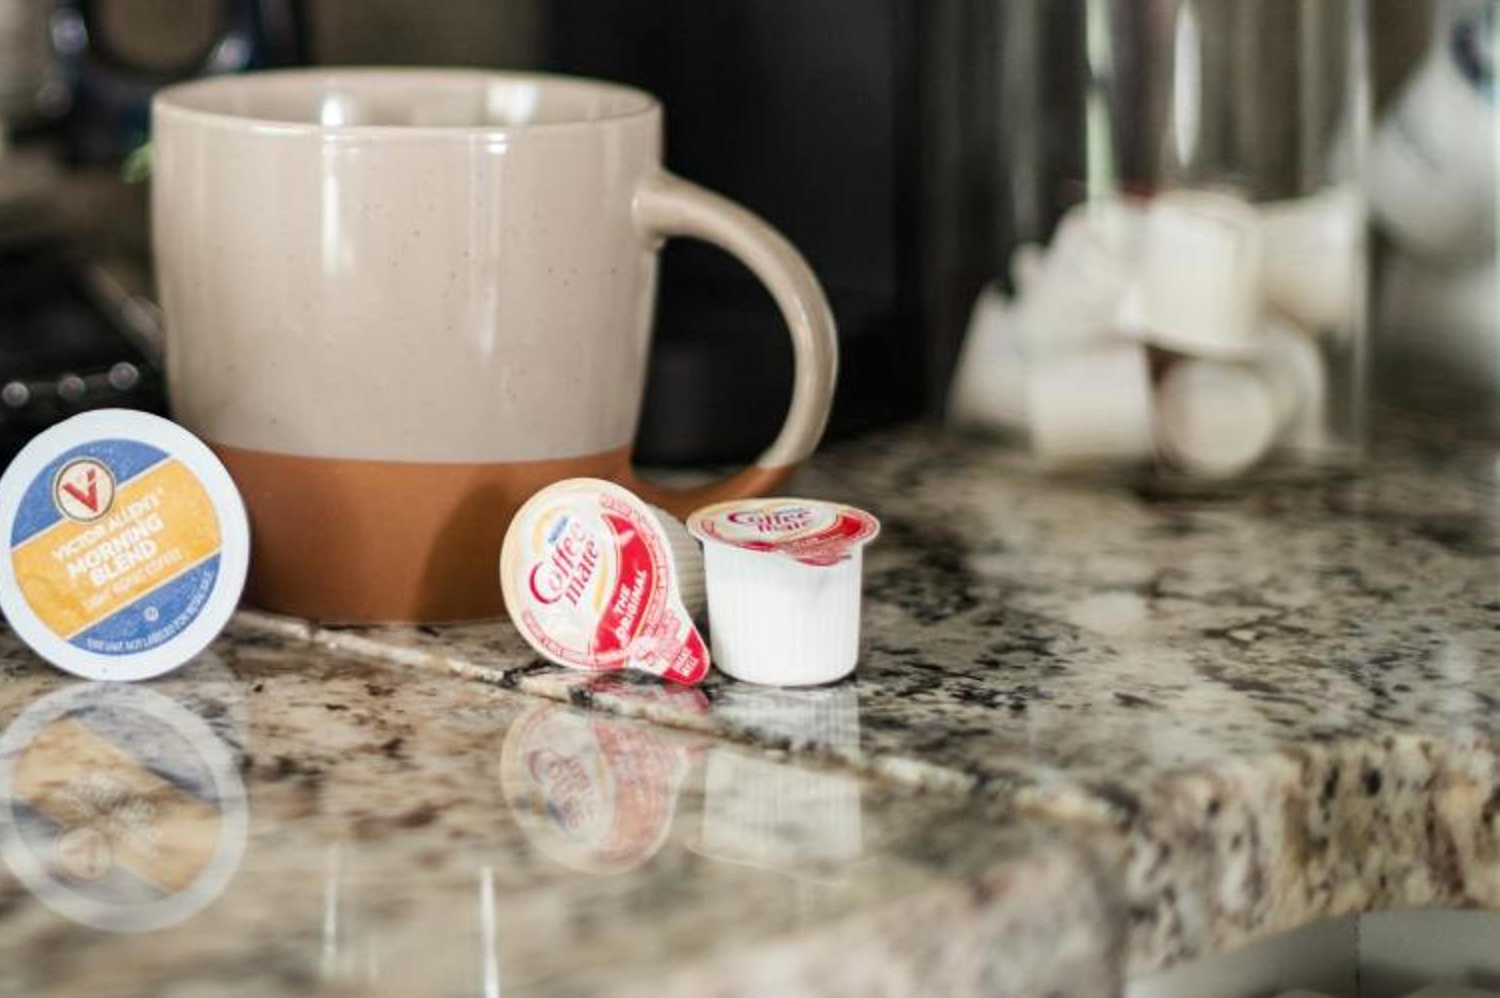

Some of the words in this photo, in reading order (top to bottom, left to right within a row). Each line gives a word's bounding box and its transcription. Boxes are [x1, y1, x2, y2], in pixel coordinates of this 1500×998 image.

[67, 513, 164, 579] MORNING
[727, 510, 806, 525] Coffee
[89, 539, 157, 587] BLEND
[529, 521, 583, 604] Coffee
[565, 540, 597, 607] mate
[615, 580, 631, 617] THE
[616, 569, 648, 647] ORIGINAL
